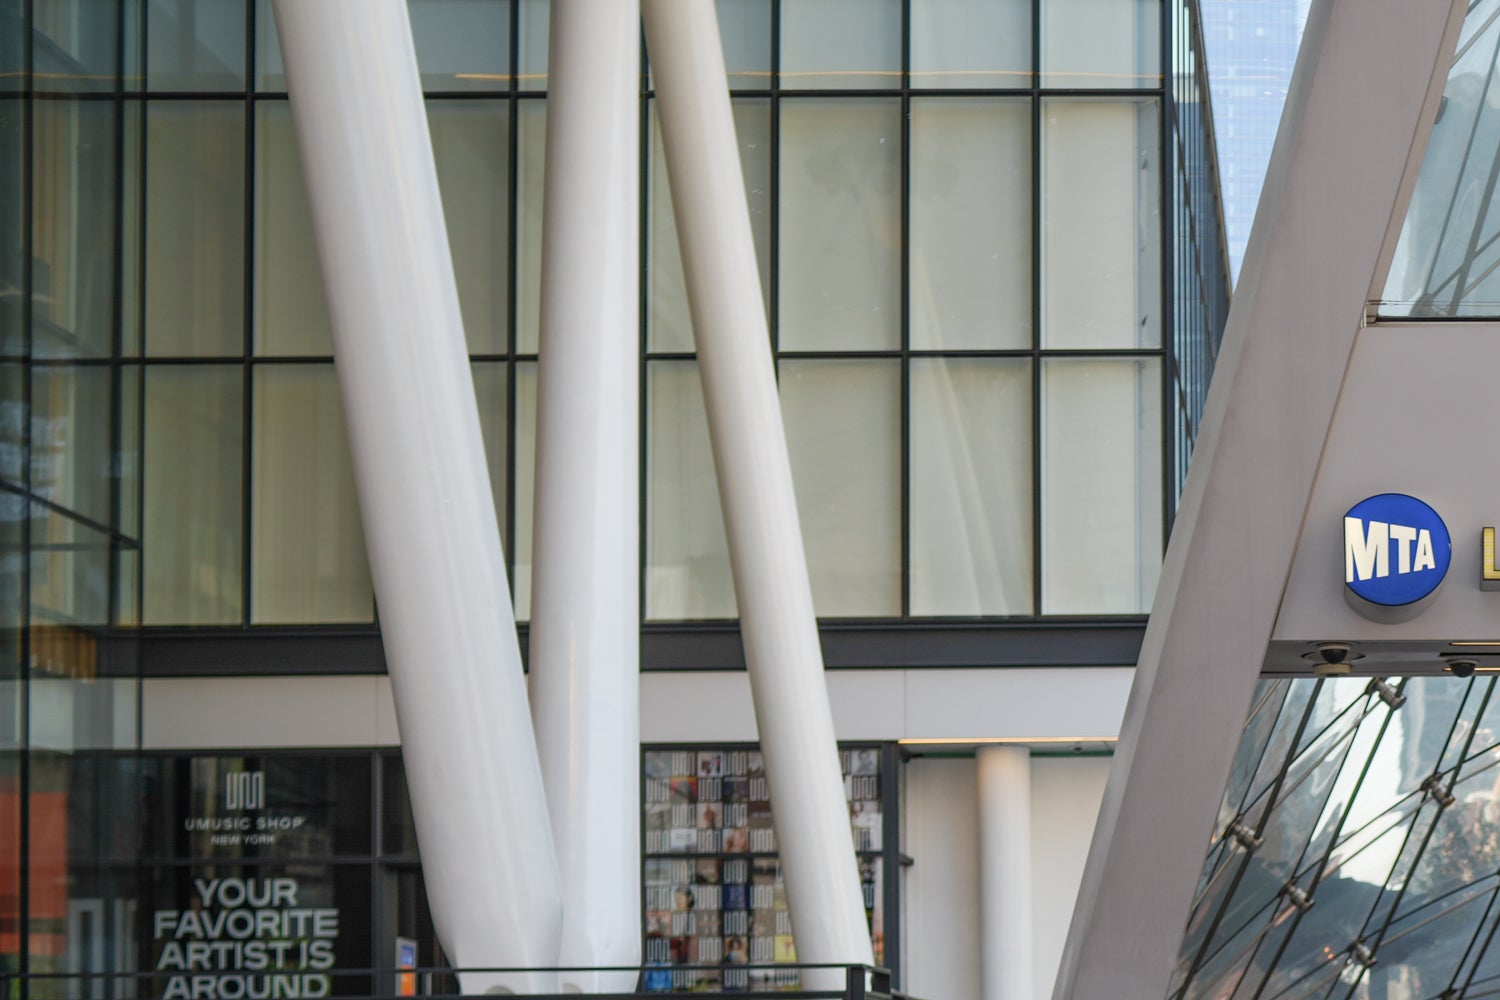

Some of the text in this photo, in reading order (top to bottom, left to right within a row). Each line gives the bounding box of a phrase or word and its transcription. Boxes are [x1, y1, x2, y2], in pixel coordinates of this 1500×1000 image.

[1344, 516, 1436, 583] MTA
[184, 816, 304, 831] UMUSIC SHOP
[211, 834, 275, 846] NEW YORK
[195, 877, 298, 907] YOUR
[154, 909, 340, 939] FAVORITE
[157, 940, 334, 970] ARTIST IS
[162, 974, 328, 1000] AROUND
